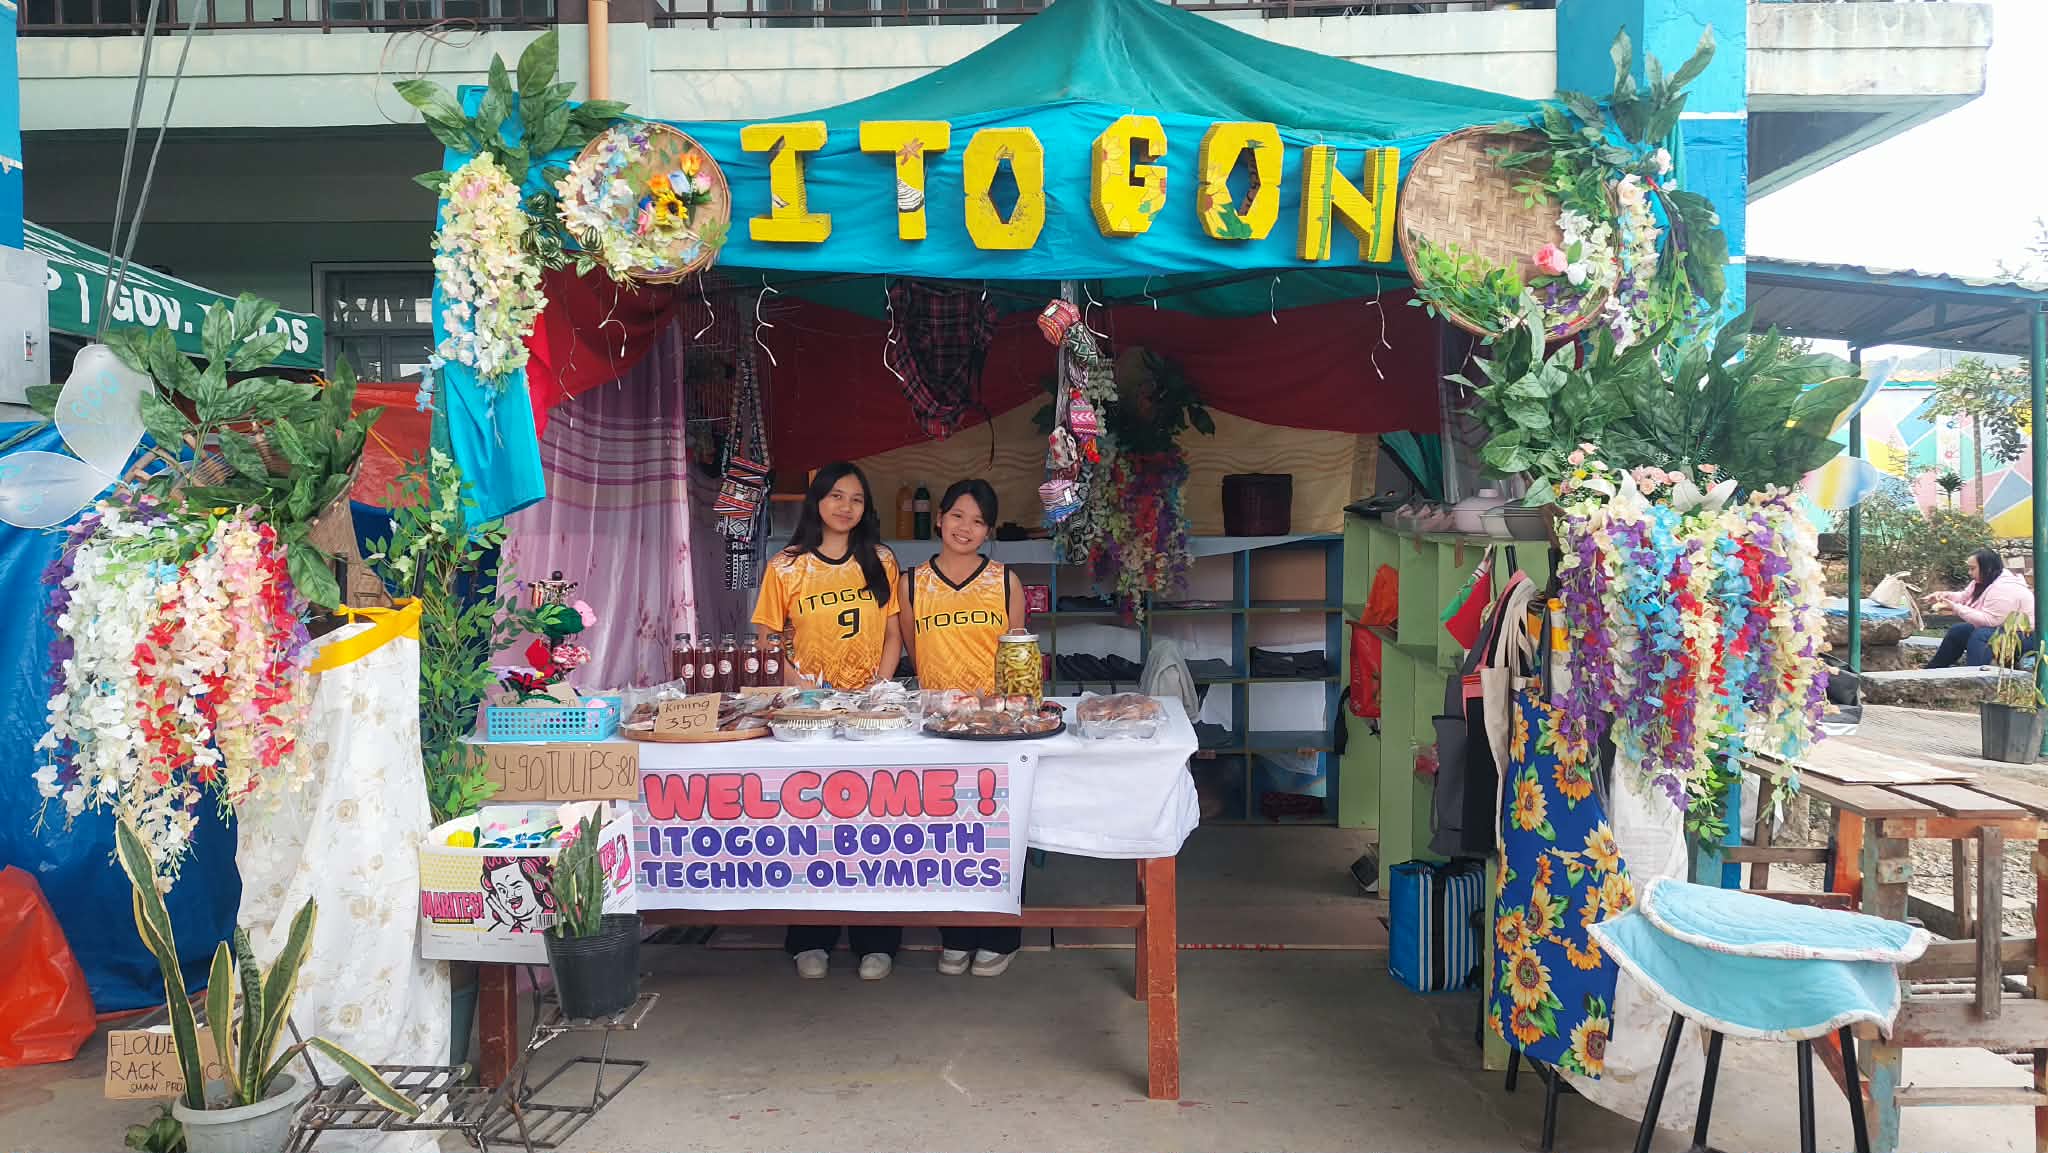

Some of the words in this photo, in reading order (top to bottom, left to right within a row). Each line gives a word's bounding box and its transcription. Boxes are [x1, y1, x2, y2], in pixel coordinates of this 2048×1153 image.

[740, 115, 1400, 263] ITOGON
[798, 588, 875, 615] ITOGO
[837, 607, 860, 639] 9
[915, 610, 1003, 635] ITOGON
[665, 714, 708, 730] 350
[643, 769, 959, 821] WELCOME
[649, 824, 819, 857] ITOGON
[832, 822, 986, 856] BOOTH
[641, 860, 793, 888] TECHNO
[805, 857, 1002, 888] OLYMPICS
[422, 891, 486, 919] MARITES!
[110, 1035, 177, 1057] FLOWE
[110, 1060, 165, 1080] RACK
